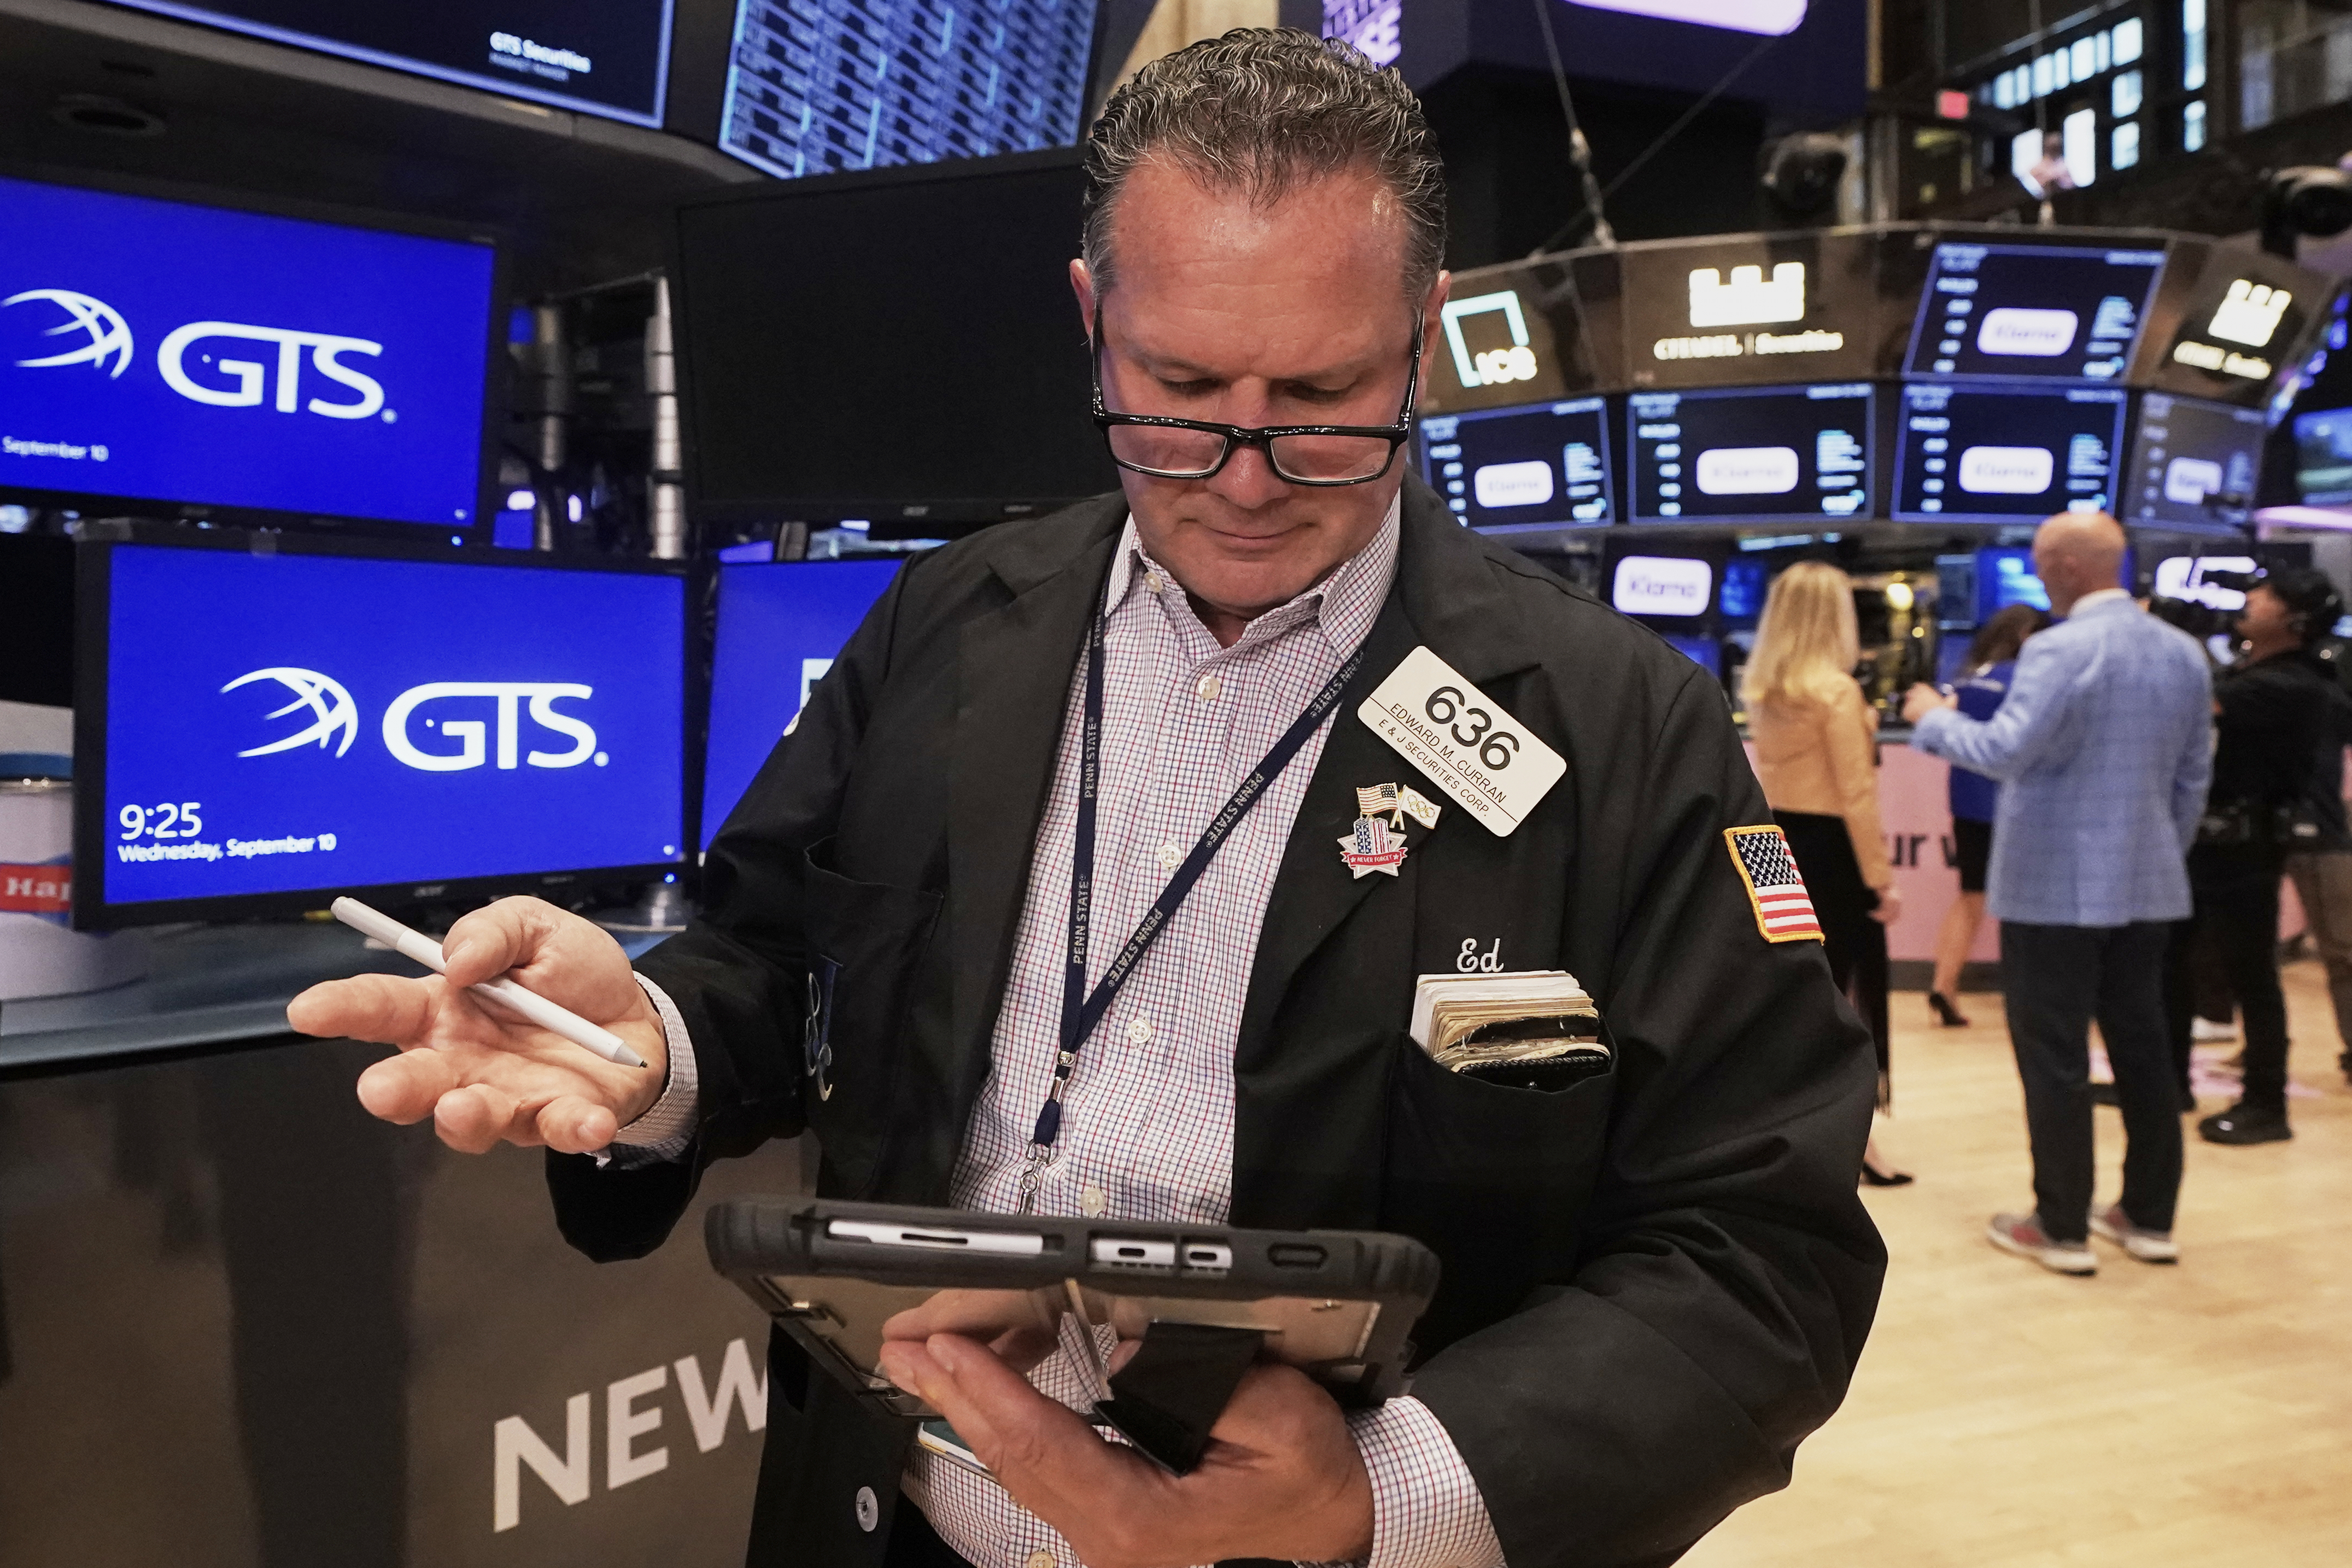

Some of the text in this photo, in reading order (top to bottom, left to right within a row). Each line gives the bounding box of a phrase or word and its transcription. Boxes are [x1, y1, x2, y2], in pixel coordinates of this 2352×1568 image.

[157, 321, 385, 420] GTS
[382, 682, 598, 772] GTS
[1425, 686, 1519, 770] 636
[1378, 719, 1389, 728] E
[1388, 727, 1396, 736] &
[1405, 742, 1460, 789] SECURITIES
[1460, 789, 1489, 816] CORP.
[1390, 703, 1507, 803] EDWARD M. CURRAN
[1084, 763, 1094, 798] PENN
[1234, 771, 1264, 806] PENN
[119, 801, 202, 840] 9:25
[118, 833, 337, 862] Wednesday, September 10
[1374, 854, 1393, 863] FORGET
[1073, 925, 1086, 964] PENN
[1135, 908, 1163, 945] PENN
[1456, 938, 1504, 973] Ed
[493, 1337, 768, 1534] NEW
